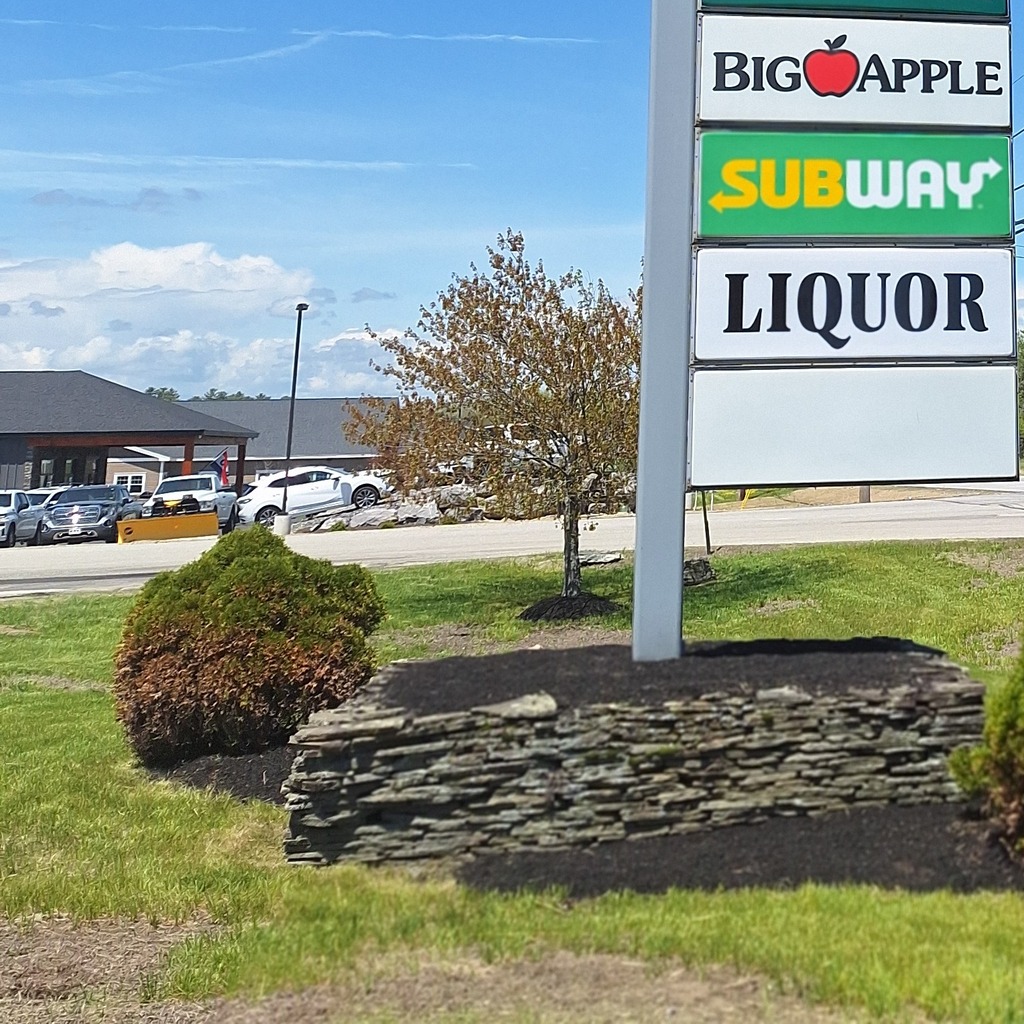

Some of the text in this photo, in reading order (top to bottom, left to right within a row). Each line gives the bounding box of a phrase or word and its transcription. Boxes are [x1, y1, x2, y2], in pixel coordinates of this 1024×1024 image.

[712, 51, 1003, 95] BIG APPLE
[708, 157, 1003, 214] SUBWAY
[723, 272, 988, 350] LIQUOR
